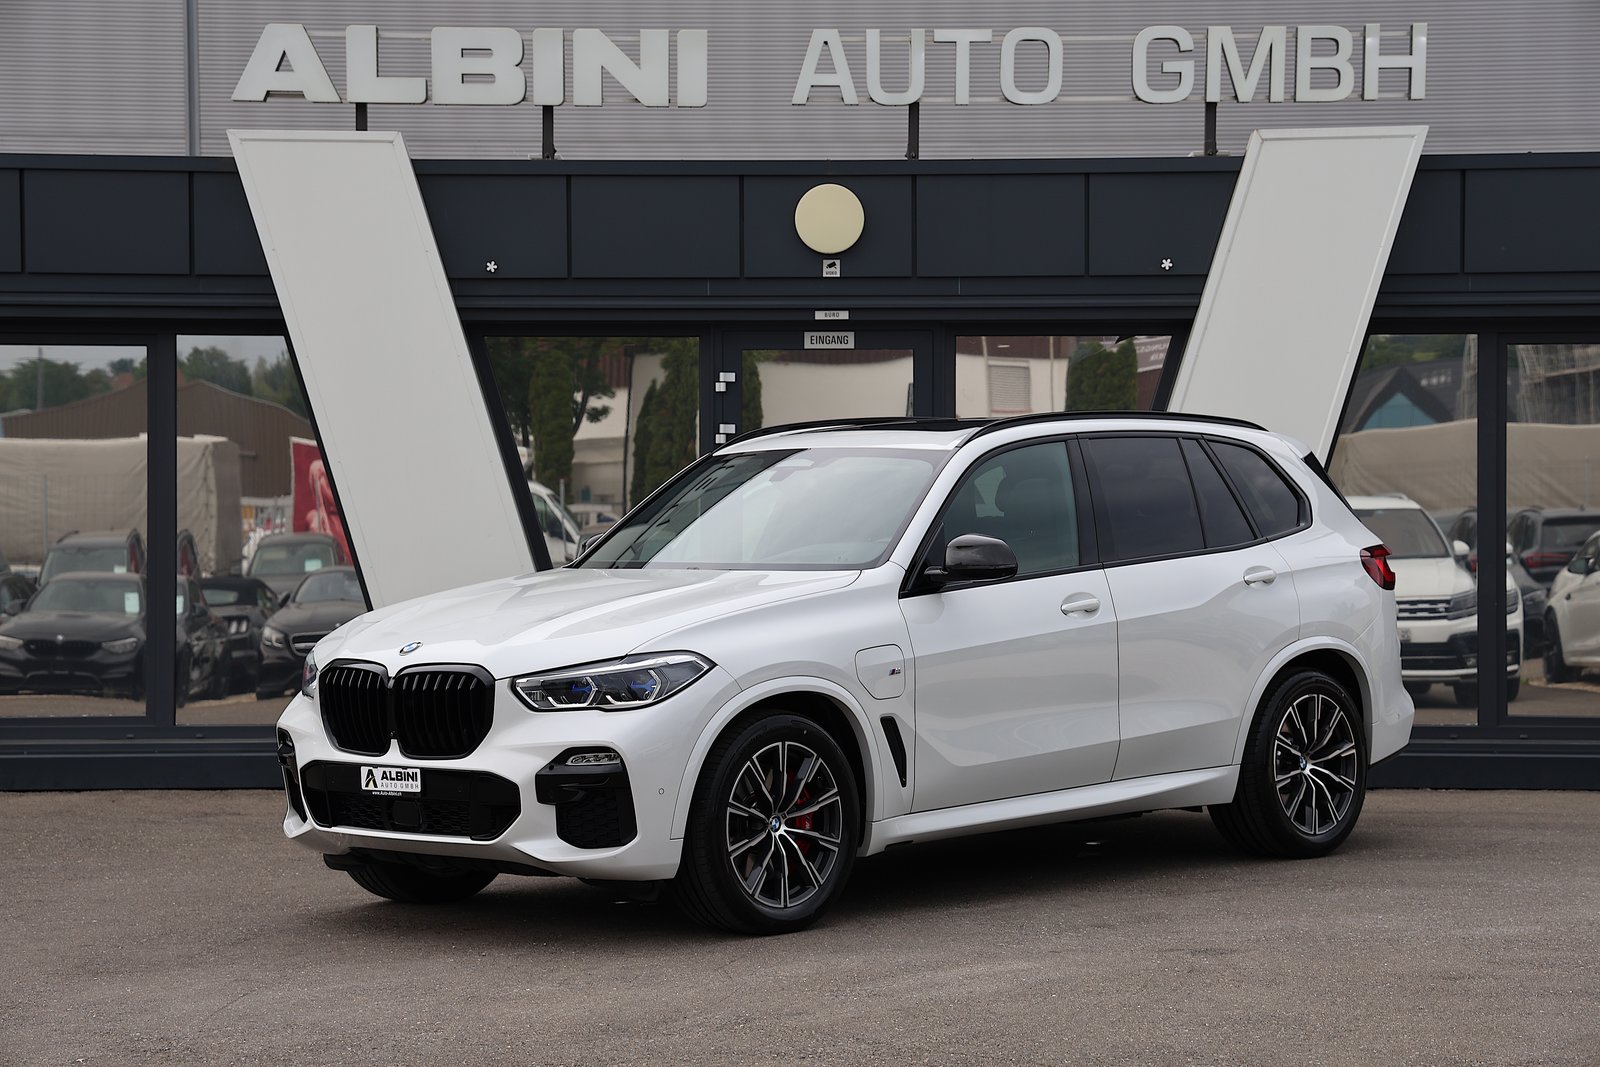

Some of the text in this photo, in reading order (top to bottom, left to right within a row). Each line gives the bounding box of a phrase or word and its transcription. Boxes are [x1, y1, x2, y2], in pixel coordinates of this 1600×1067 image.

[231, 22, 1429, 108] ALBINI AUTO GMBH
[810, 335, 849, 345] EINGANG
[380, 770, 418, 782] ALBINI
